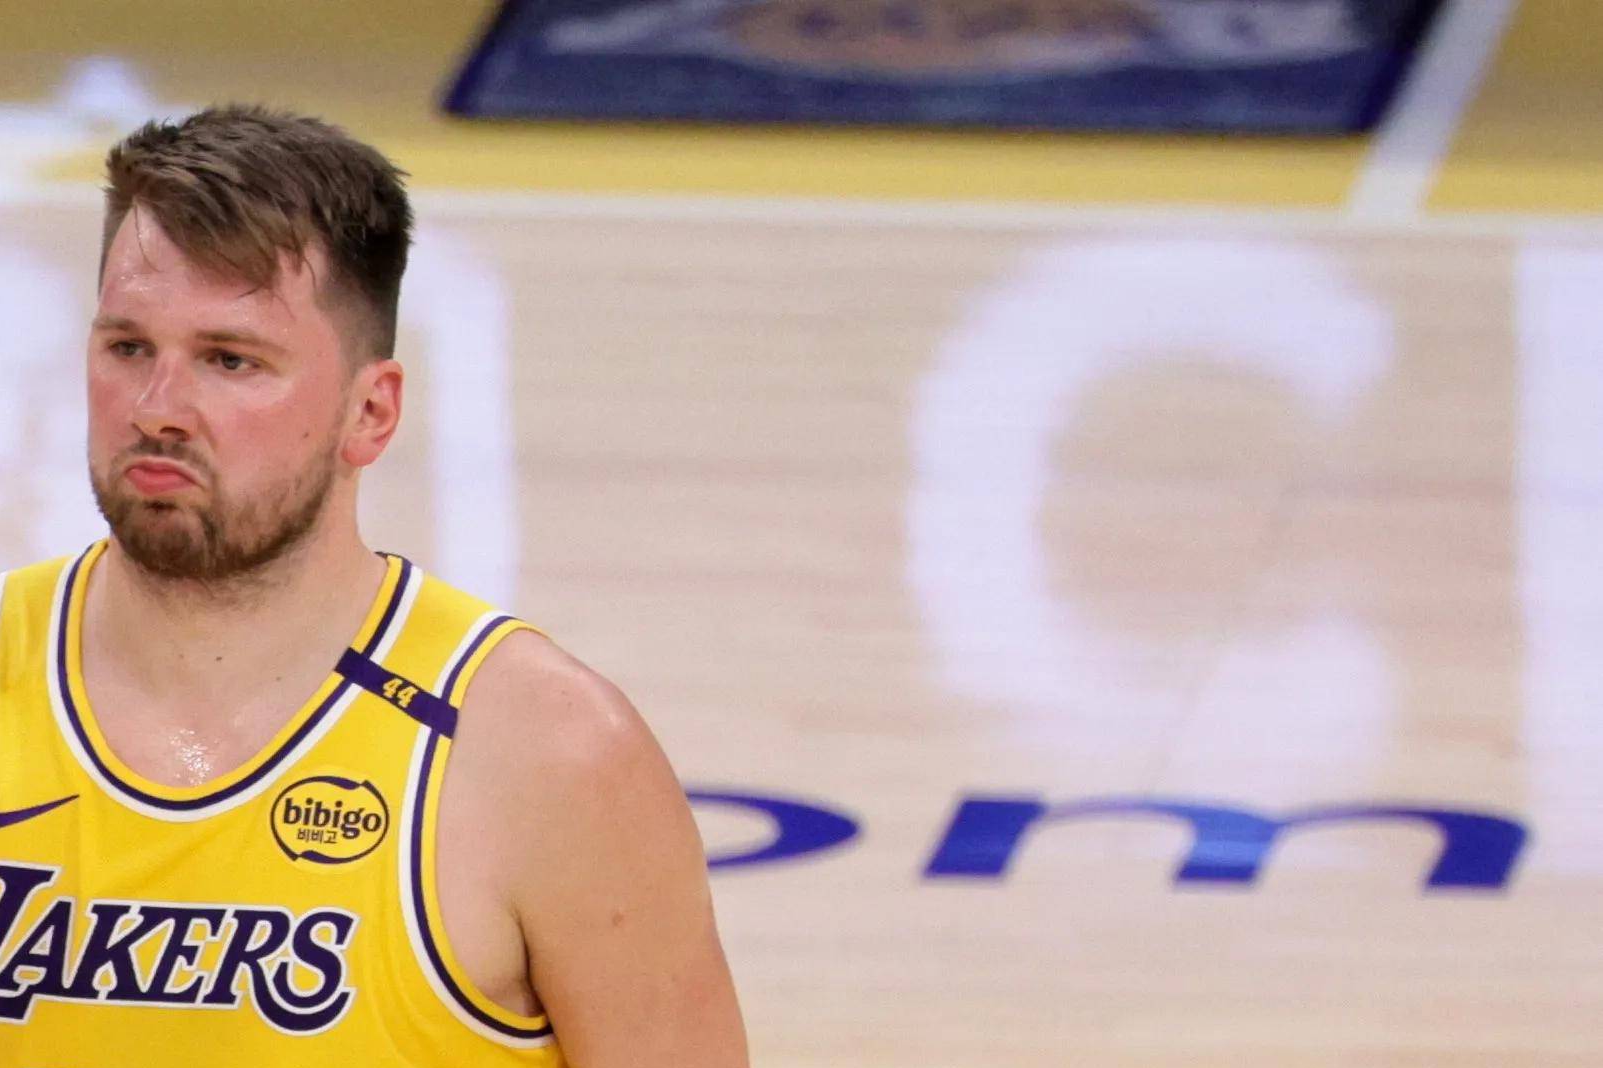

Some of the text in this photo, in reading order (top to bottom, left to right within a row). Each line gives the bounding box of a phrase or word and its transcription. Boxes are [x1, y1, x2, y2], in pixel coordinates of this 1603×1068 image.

[382, 678, 418, 708] 44
[283, 797, 382, 840] bibigo
[297, 828, 338, 844] 비비고
